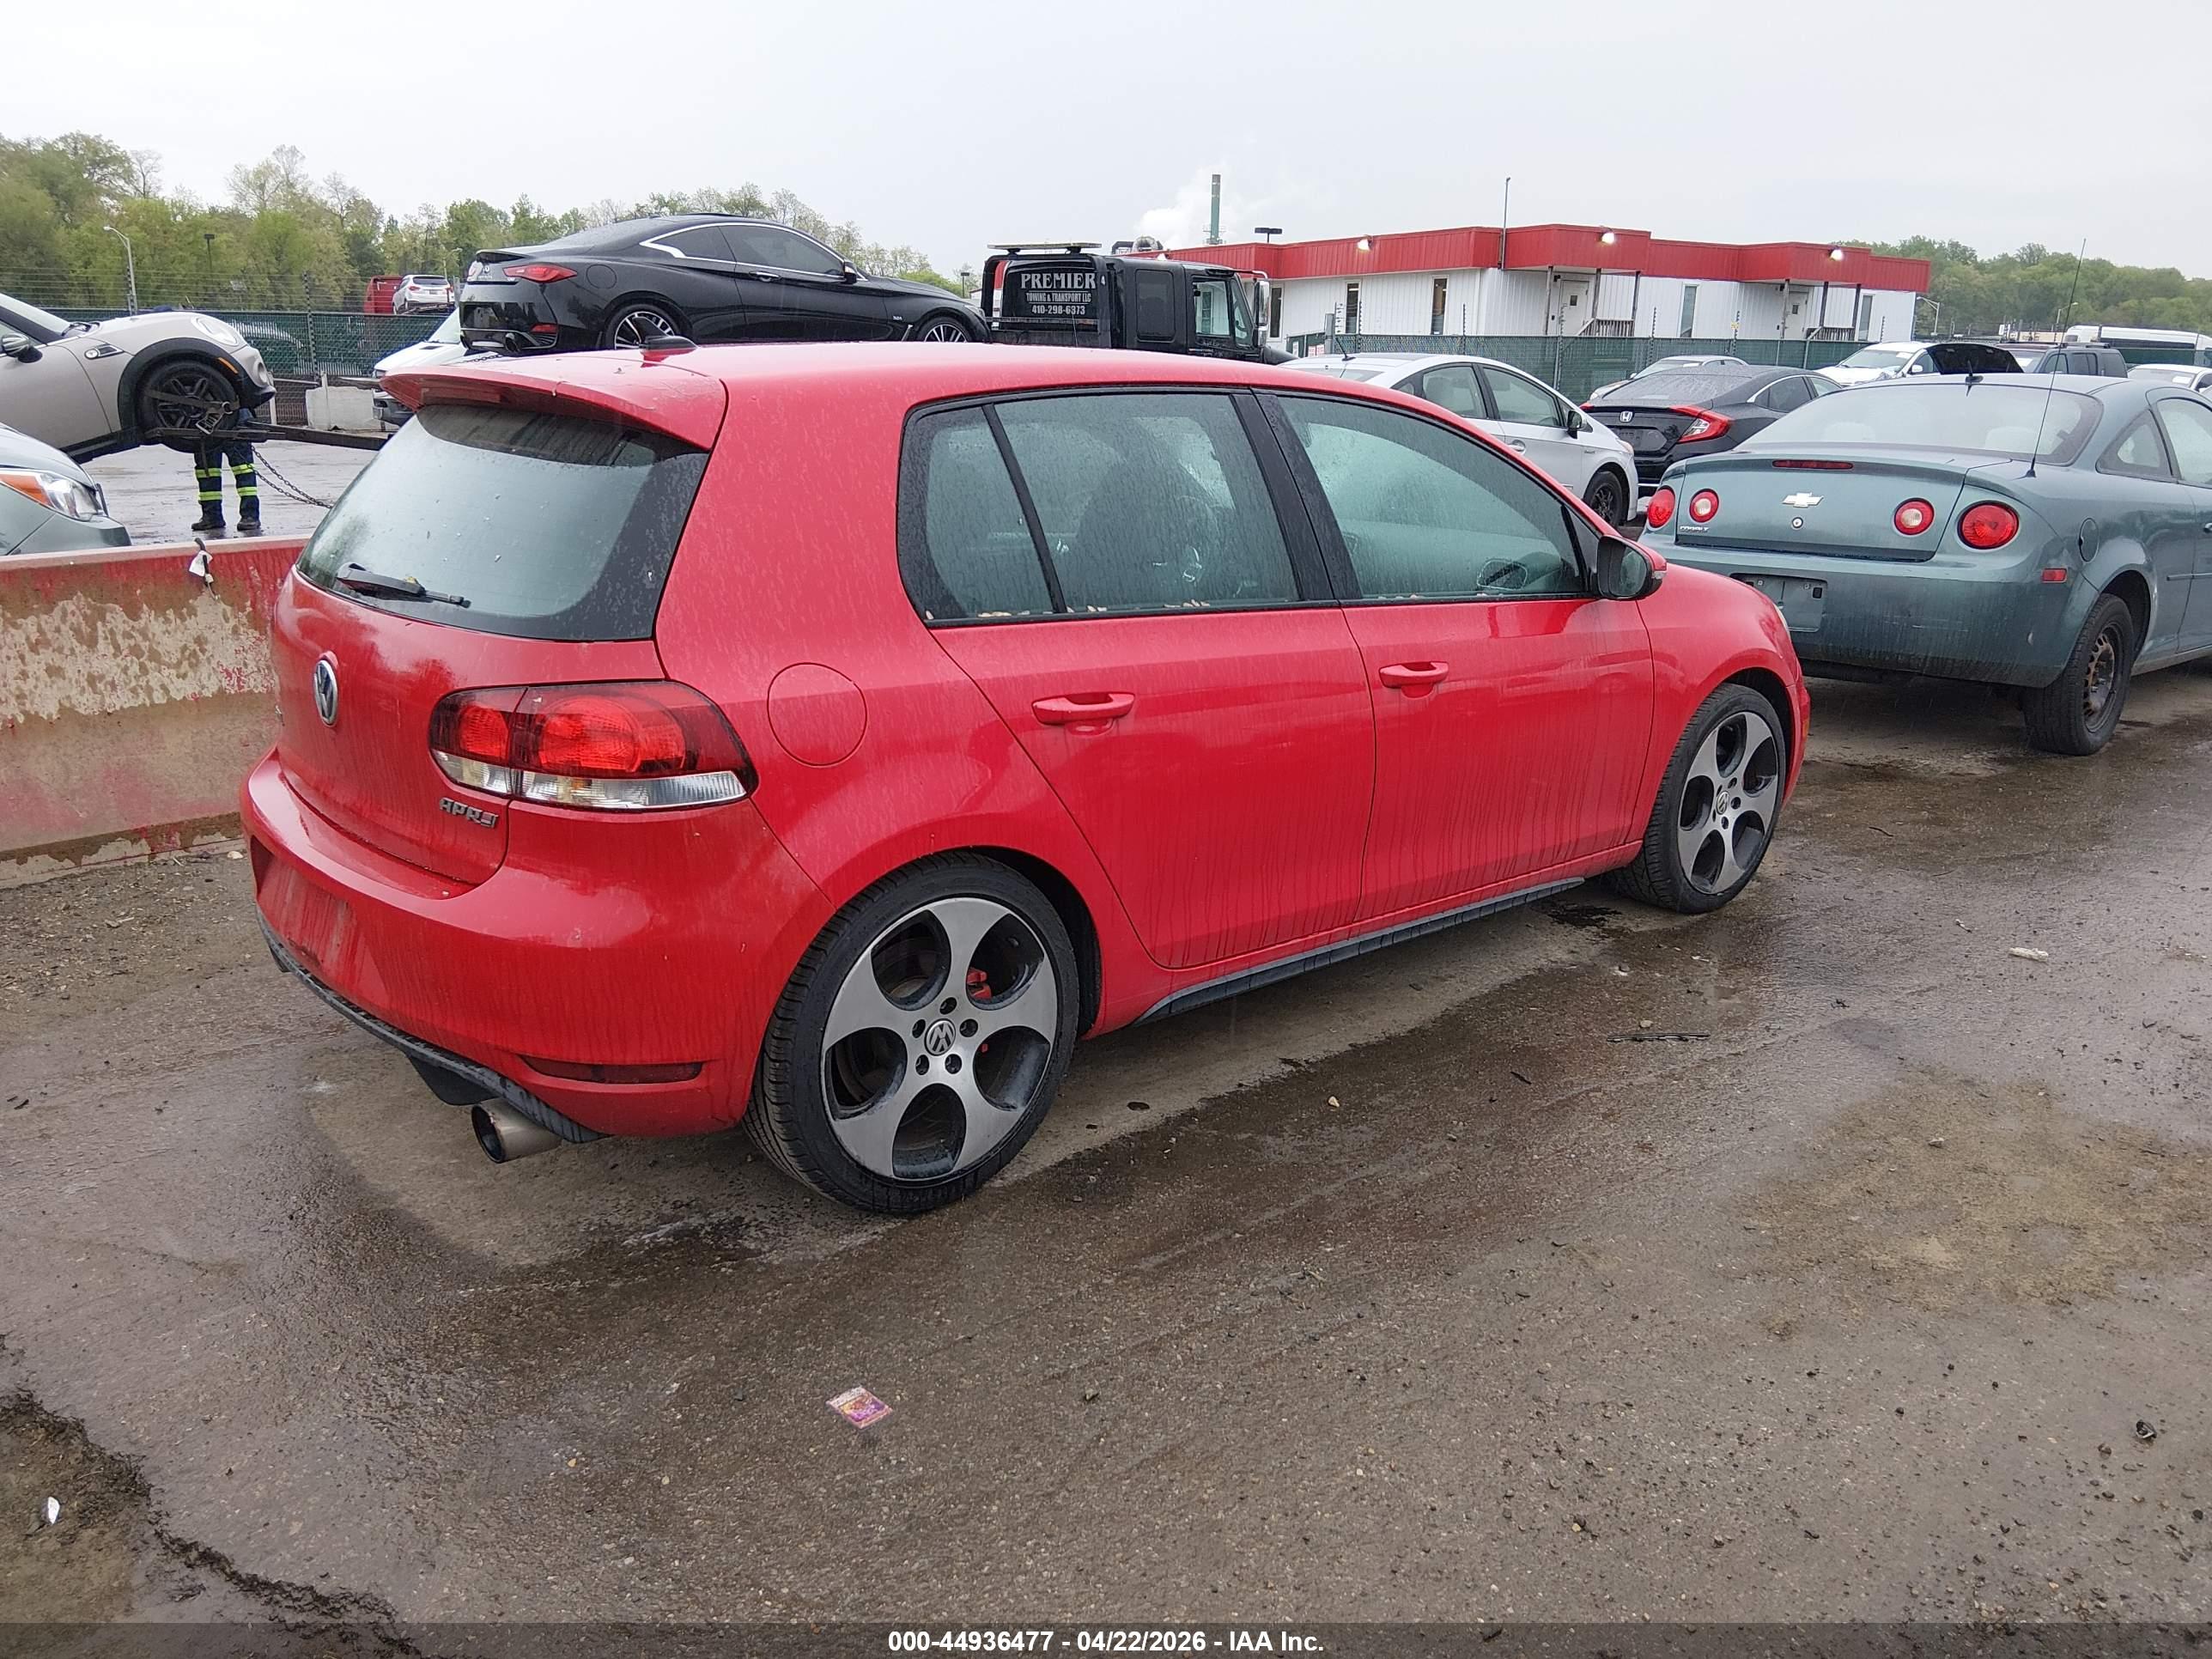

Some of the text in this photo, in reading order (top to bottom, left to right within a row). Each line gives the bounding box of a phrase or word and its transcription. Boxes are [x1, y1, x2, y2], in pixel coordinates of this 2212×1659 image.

[1021, 273, 1096, 289] PREMIER
[1026, 293, 1046, 301] TOWING
[1052, 293, 1081, 302] TRANSPORT
[1082, 293, 1091, 302] LLC
